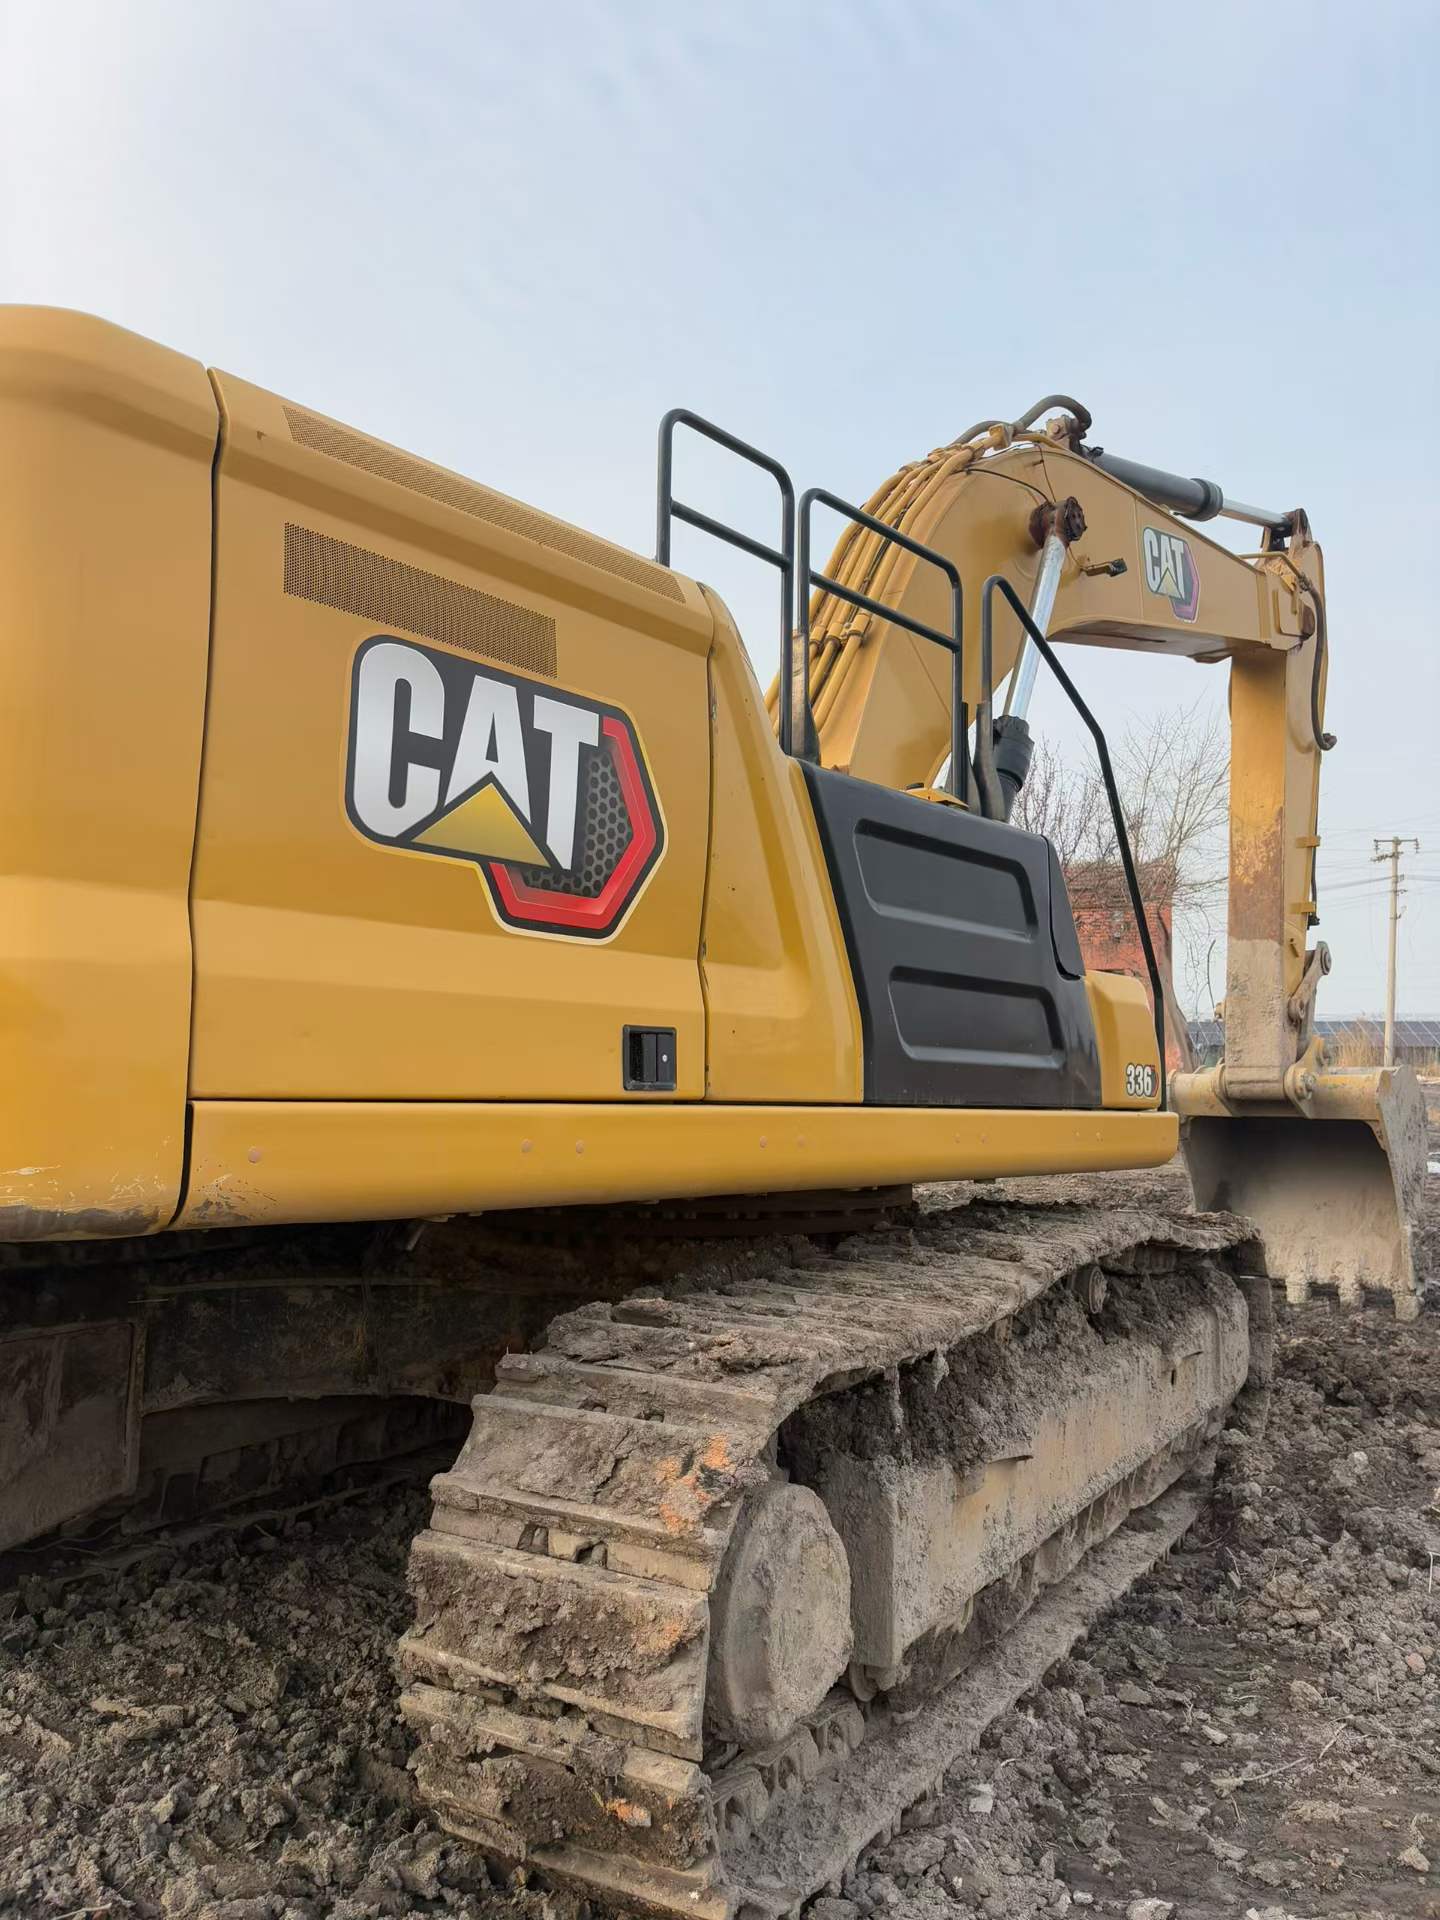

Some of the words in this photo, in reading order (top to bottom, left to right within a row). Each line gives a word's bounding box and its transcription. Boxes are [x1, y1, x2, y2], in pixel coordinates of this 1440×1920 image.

[1143, 528, 1185, 600] CAT
[353, 642, 599, 870] CAT
[1126, 1064, 1152, 1096] 336
